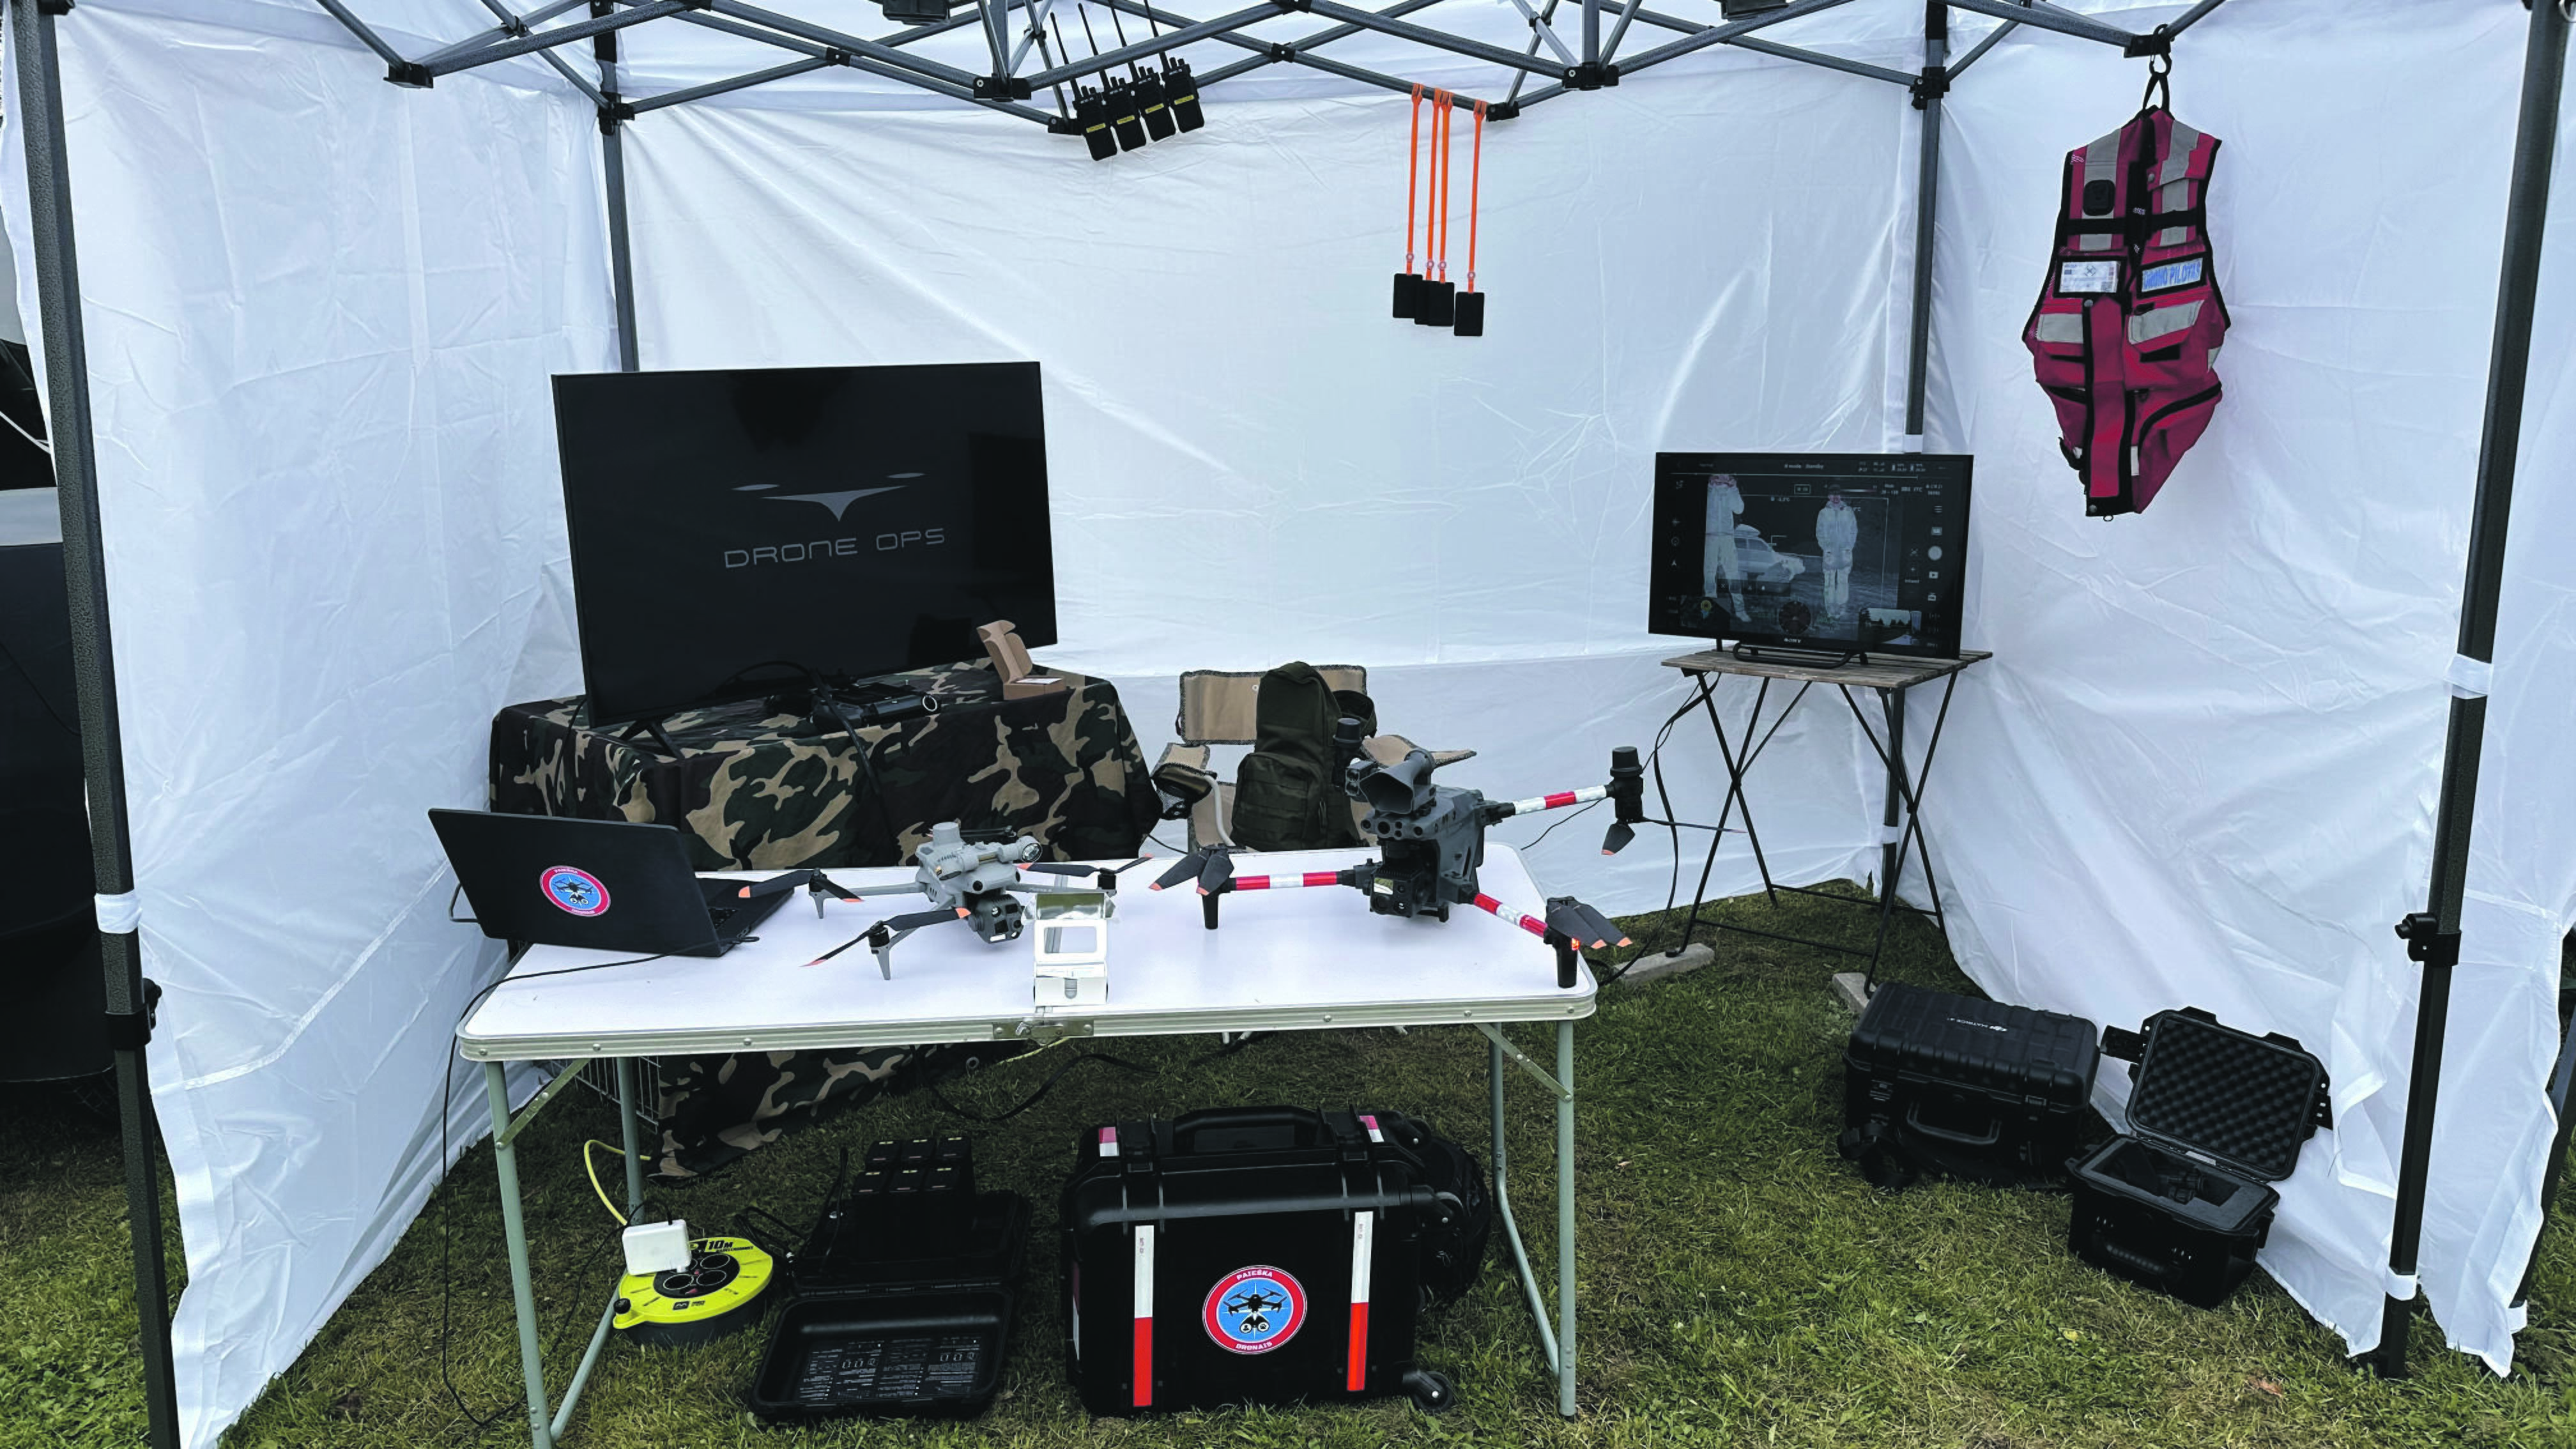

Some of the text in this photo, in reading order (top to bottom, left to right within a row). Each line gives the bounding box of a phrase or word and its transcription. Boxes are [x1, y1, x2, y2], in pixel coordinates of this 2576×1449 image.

[724, 528, 945, 568] DRONE OPS
[1236, 1269, 1273, 1280] PAIEŠKA
[1235, 1342, 1273, 1351] DRONAIS
